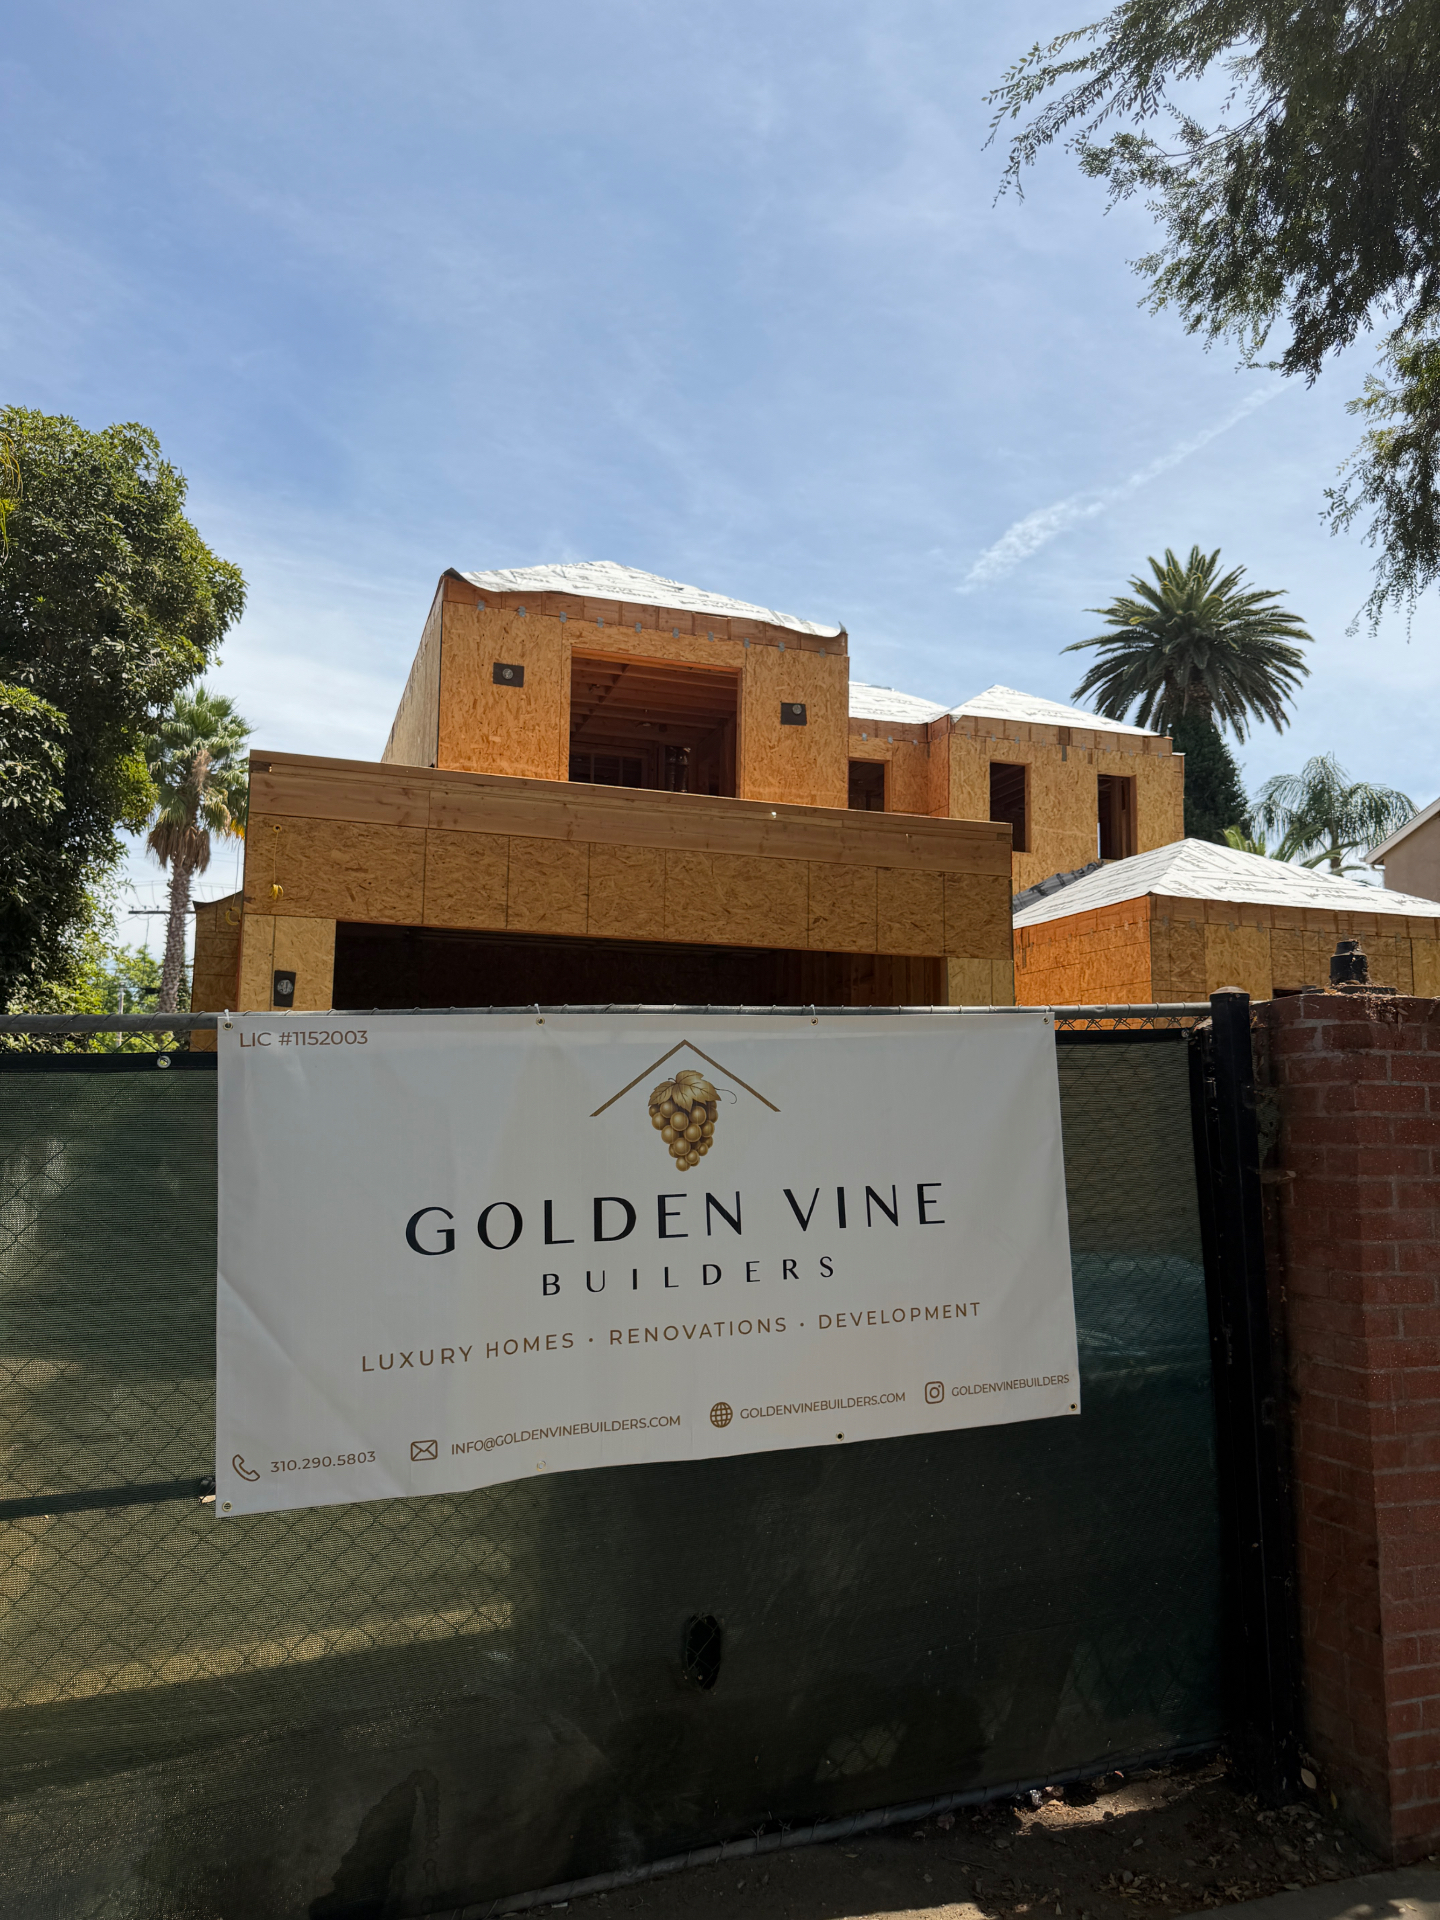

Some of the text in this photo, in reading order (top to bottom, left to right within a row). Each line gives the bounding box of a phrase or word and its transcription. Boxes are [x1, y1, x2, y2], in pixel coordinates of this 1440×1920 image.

[239, 1030, 368, 1048] LIC #1152003
[405, 1182, 946, 1256] GOLDEN VINE
[542, 1255, 834, 1297] BUILDERS
[362, 1301, 981, 1373] LUXURY HOMES RENOVATIONS DEVELOPMENT
[951, 1373, 1070, 1397] GOLDENVINEBUILDERS
[739, 1391, 906, 1420] GOLDENVINEBUILDERS.COM
[451, 1415, 681, 1456] INFO@GOLDENVINEBUILDERS.COM
[270, 1450, 376, 1473] 310.290.5803
